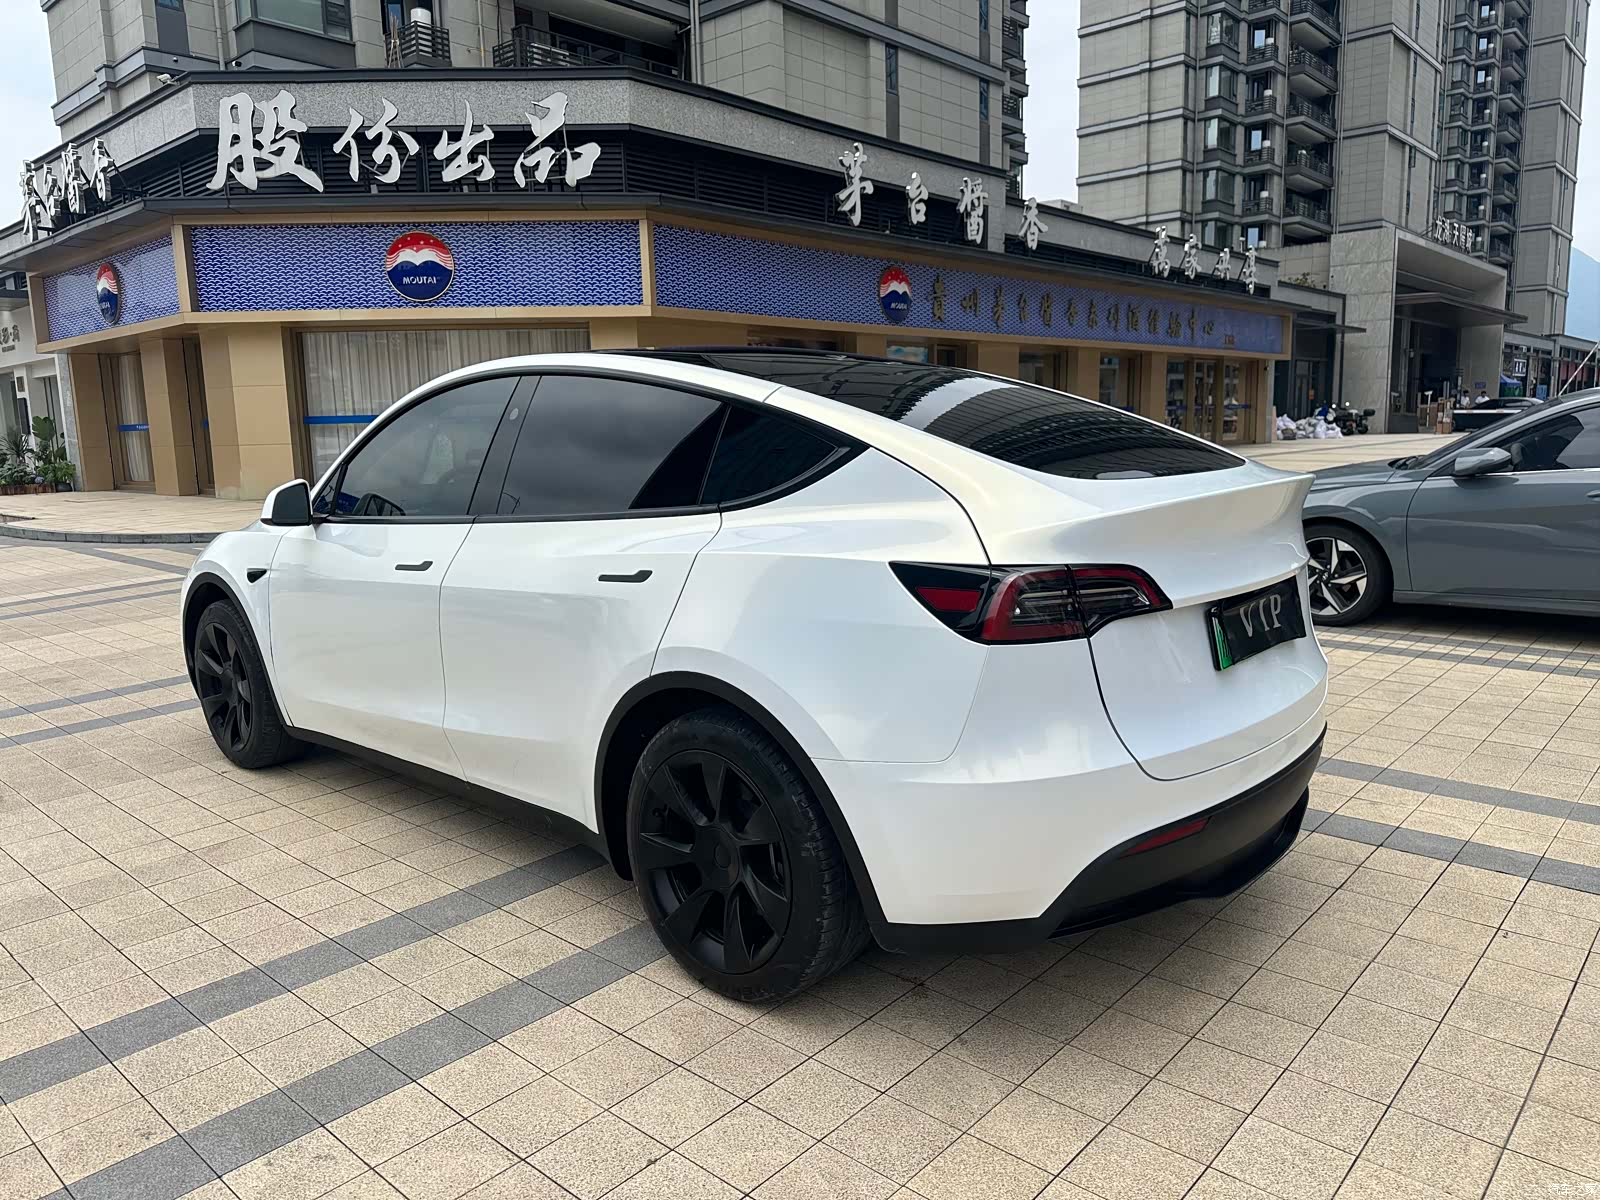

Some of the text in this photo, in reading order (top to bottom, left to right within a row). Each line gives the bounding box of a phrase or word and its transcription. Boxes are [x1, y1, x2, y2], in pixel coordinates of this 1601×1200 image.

[206, 90, 601, 192] 股份出品
[403, 276, 436, 285] MOUTAI
[1240, 594, 1281, 637] VIP
